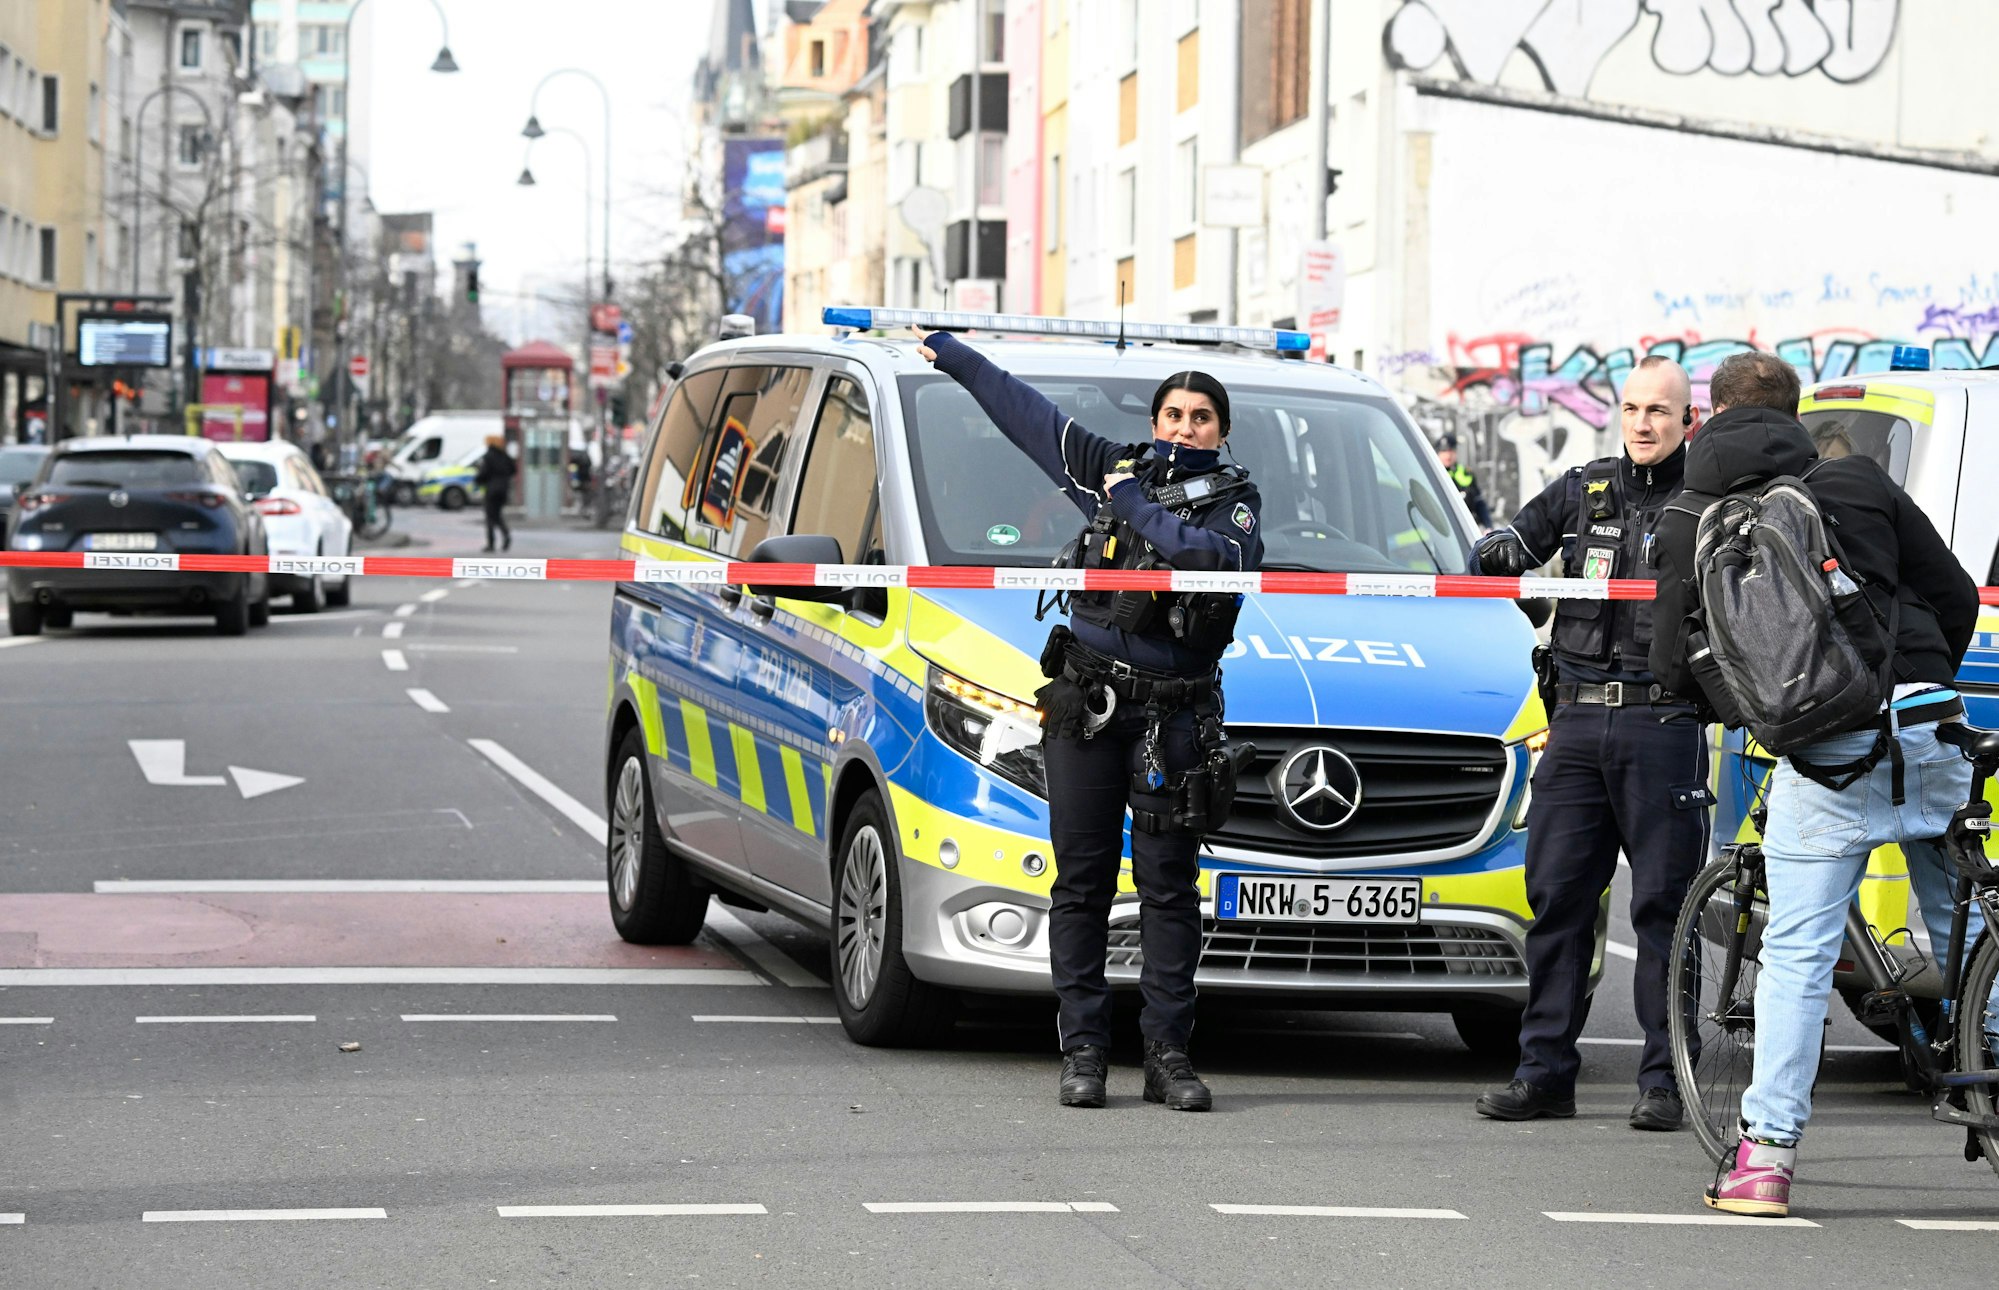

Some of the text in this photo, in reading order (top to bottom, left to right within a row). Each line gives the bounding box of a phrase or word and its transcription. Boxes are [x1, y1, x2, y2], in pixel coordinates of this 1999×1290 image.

[1591, 524, 1621, 538] POLIZEI
[1589, 550, 1611, 559] POLIZEI
[1222, 634, 1426, 668] OLIZEI
[755, 645, 813, 711] POLIZEI
[1224, 882, 1417, 918] D NRW 5-6365
